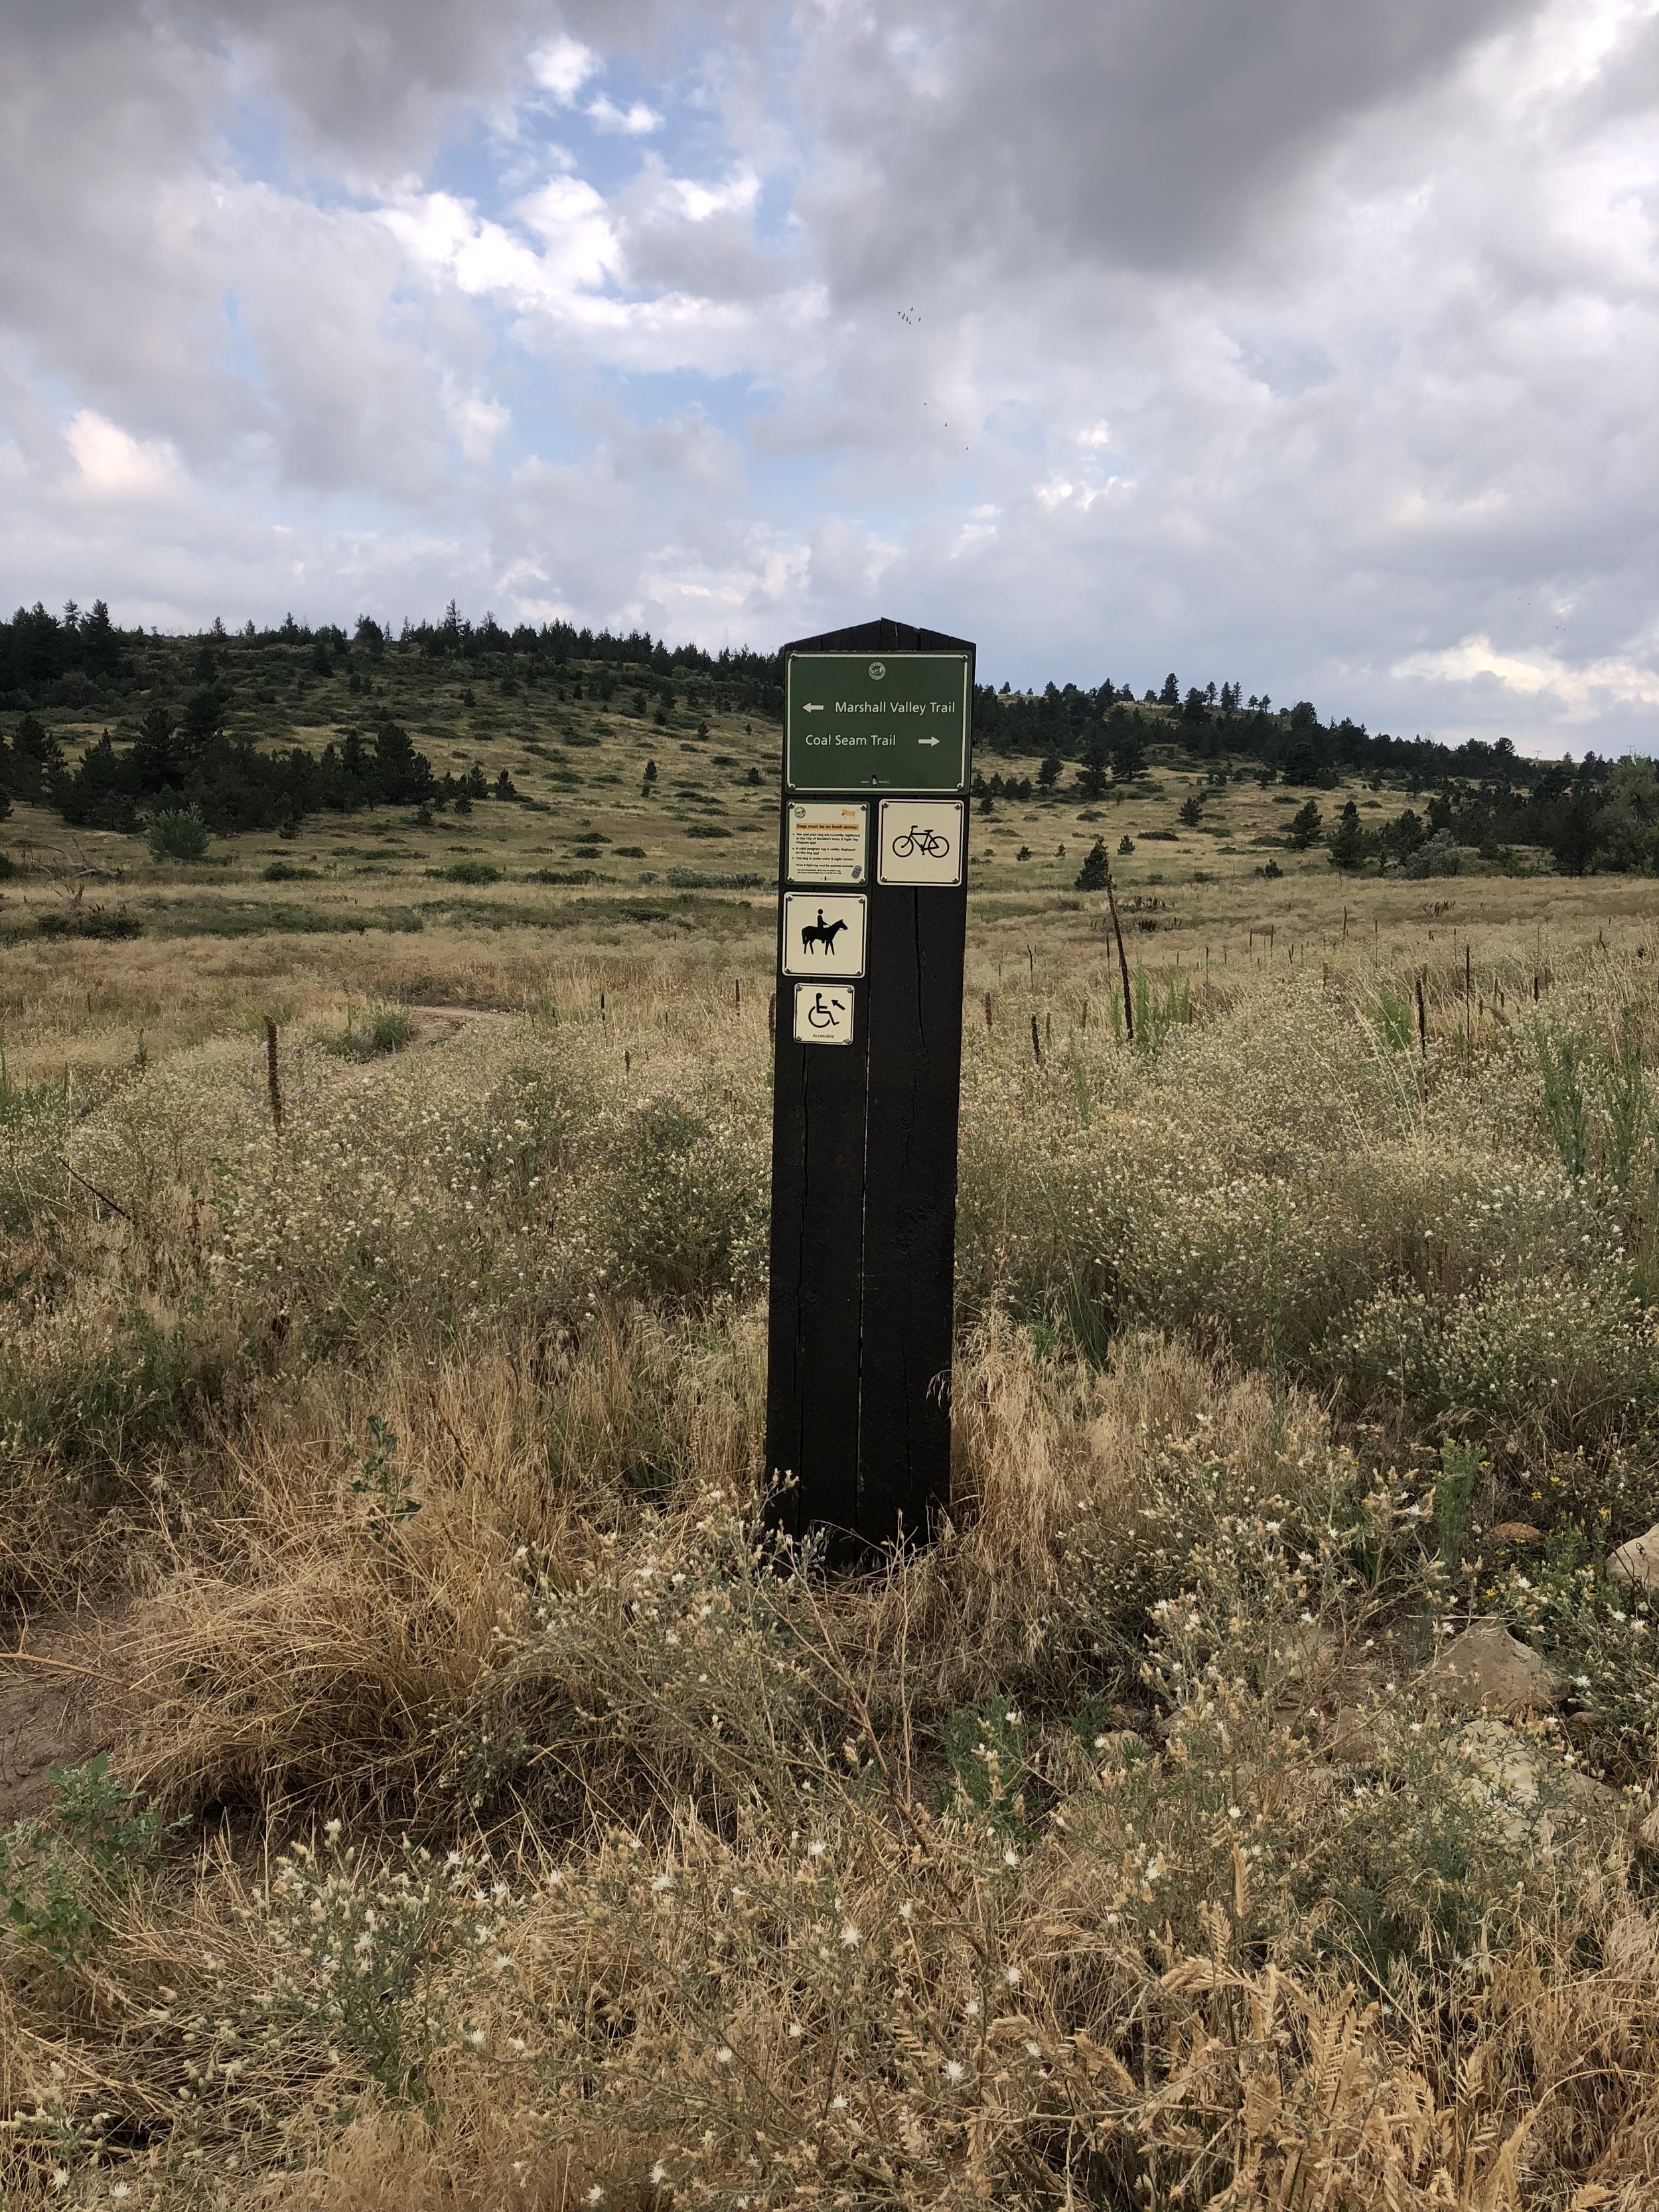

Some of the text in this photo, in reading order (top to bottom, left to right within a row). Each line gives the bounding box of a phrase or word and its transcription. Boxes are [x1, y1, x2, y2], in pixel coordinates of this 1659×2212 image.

[835, 701, 956, 715] Marshall Valley Trail
[805, 734, 896, 746] Coal Seam Trail
